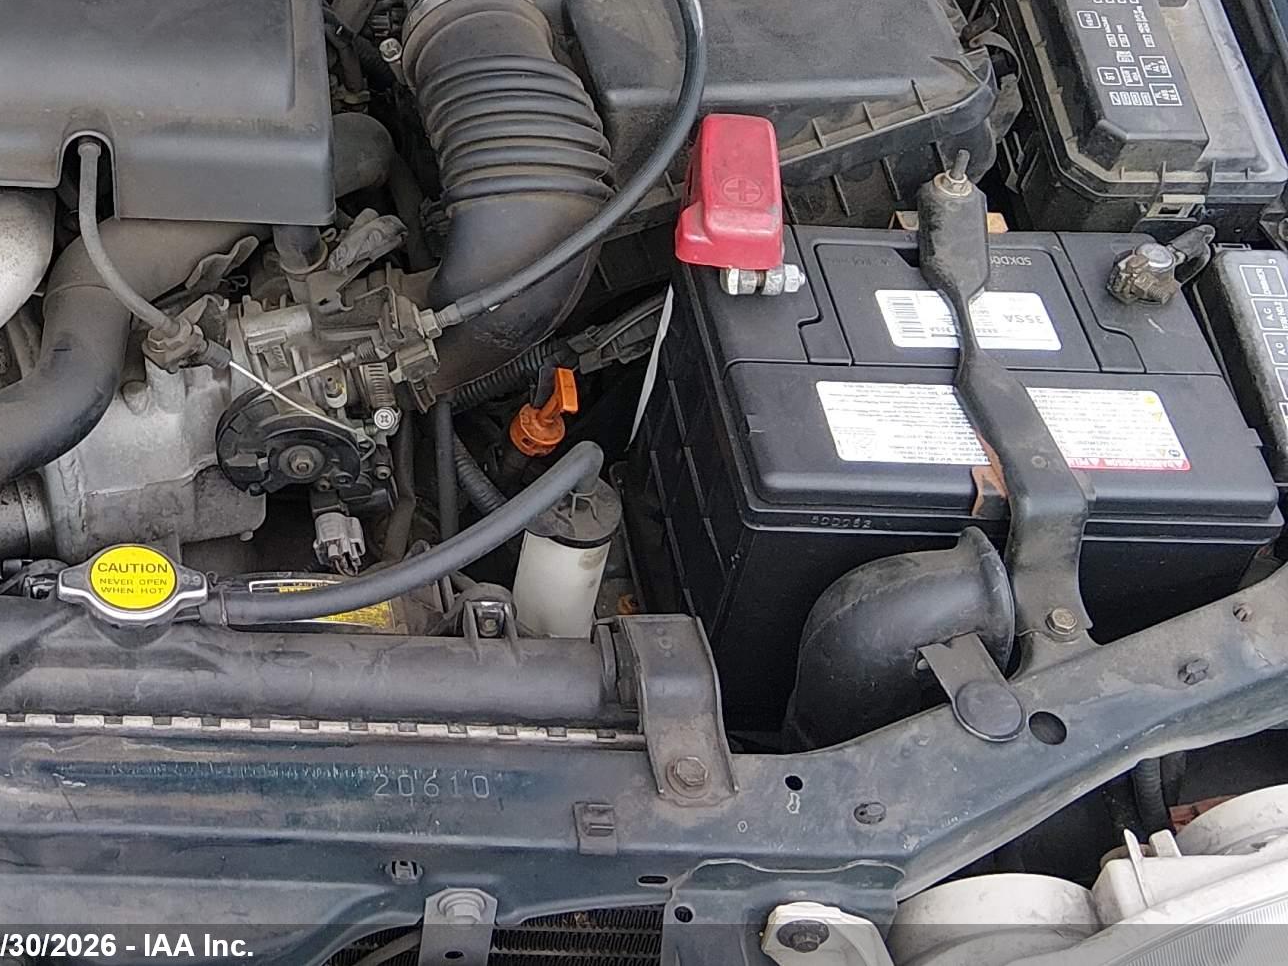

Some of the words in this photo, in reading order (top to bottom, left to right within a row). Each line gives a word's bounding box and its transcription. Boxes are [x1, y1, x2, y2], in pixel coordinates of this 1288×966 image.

[1003, 314, 1043, 324] 35SA
[98, 562, 168, 574] CAUTION
[99, 577, 134, 586] NEVER
[138, 578, 167, 586] OPEN
[100, 586, 134, 594] WHEN
[373, 772, 490, 798] 20610
